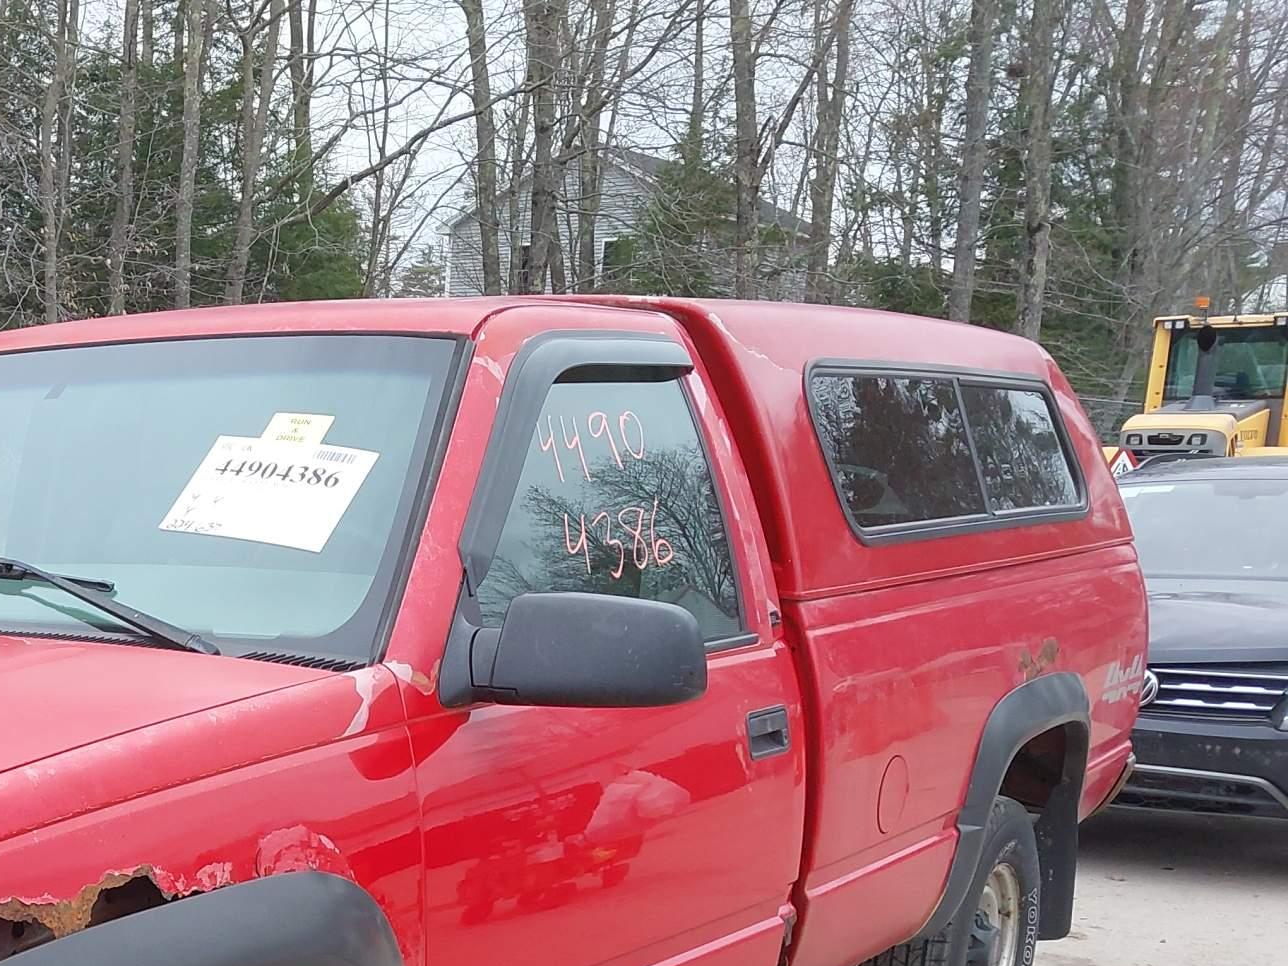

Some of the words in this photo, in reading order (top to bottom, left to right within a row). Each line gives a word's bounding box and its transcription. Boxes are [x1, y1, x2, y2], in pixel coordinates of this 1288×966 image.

[289, 418, 312, 426] RUN
[275, 434, 307, 444] DRIVE
[536, 410, 645, 482] 4490
[215, 458, 346, 489] 44904386
[564, 495, 674, 579] 4386
